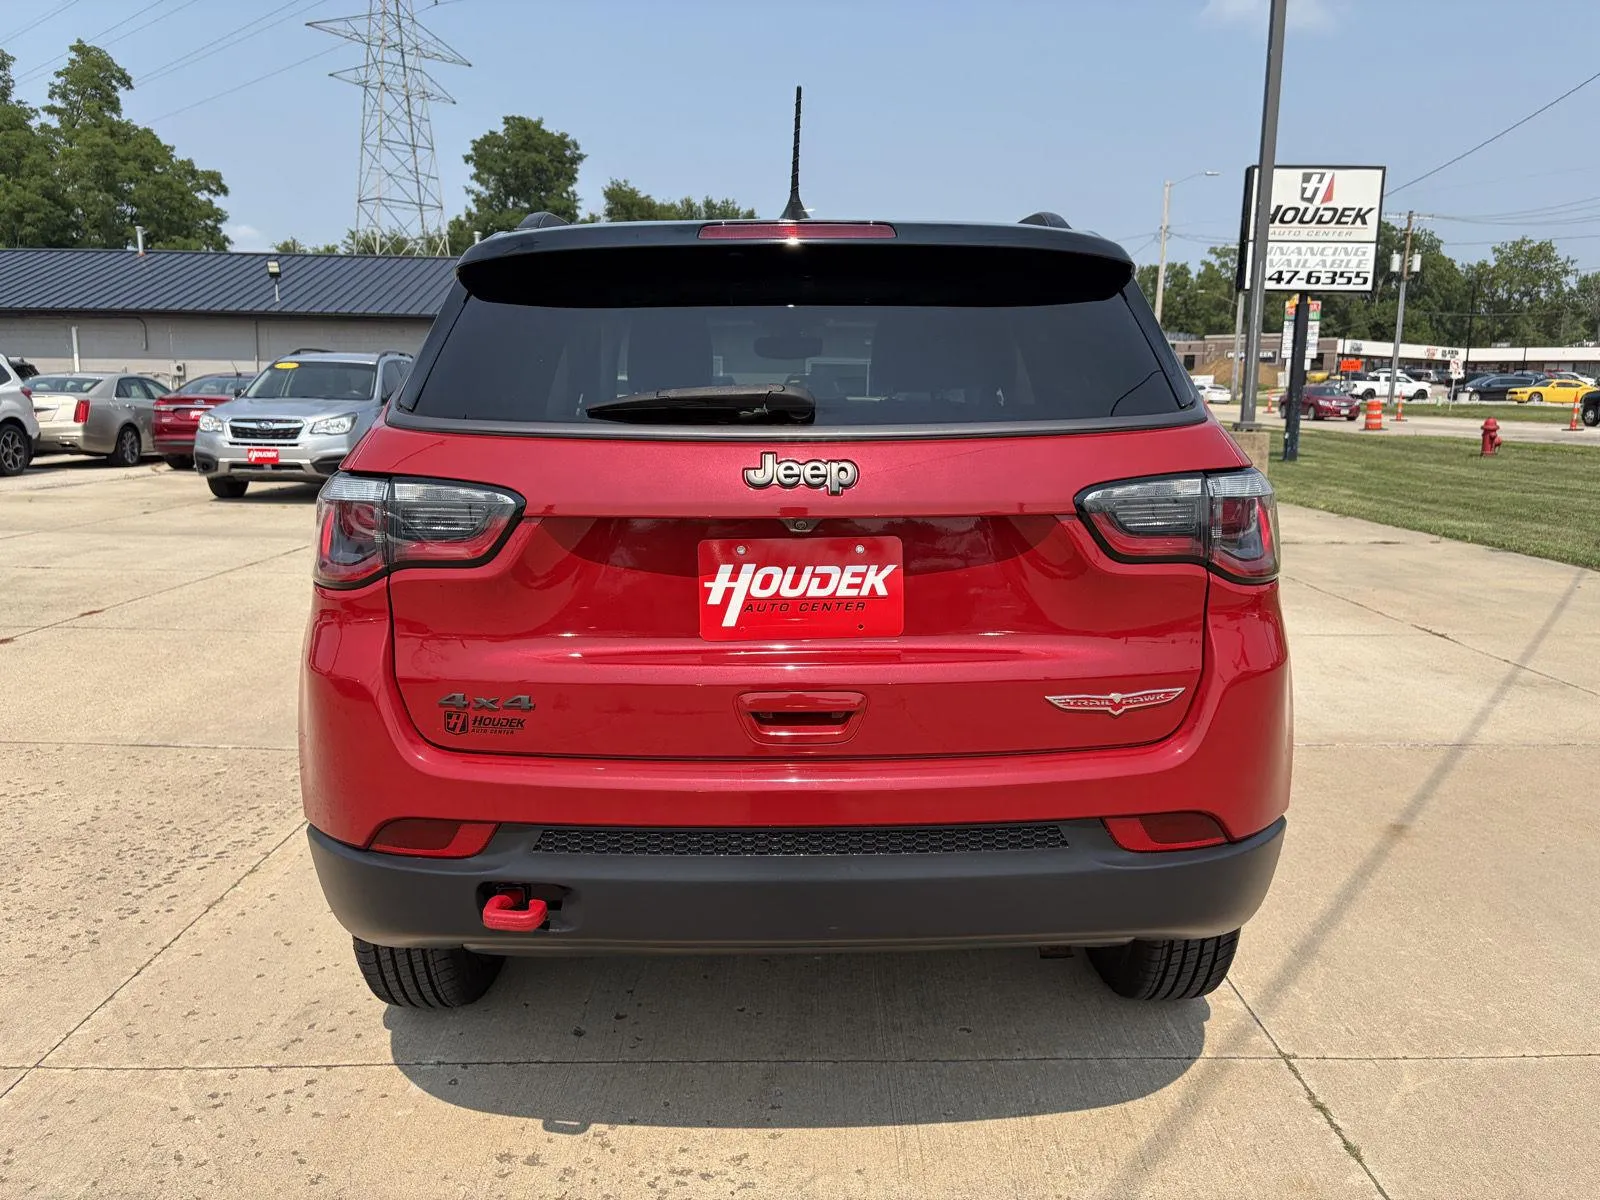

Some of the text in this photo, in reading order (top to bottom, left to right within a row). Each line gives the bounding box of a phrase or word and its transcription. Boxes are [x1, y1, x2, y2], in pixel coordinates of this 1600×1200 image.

[1306, 230, 1353, 238] CENTER
[1267, 246, 1369, 257] INANCING
[1268, 258, 1370, 269] VAILABLE
[1265, 270, 1371, 285] 47-6355
[742, 452, 860, 495] Jeep
[703, 563, 898, 627] HOUDEK
[743, 601, 866, 613] AUTO CENTER
[438, 692, 536, 711] 4x4
[1121, 693, 1166, 705] HAWK
[471, 715, 527, 728] HOUDEK
